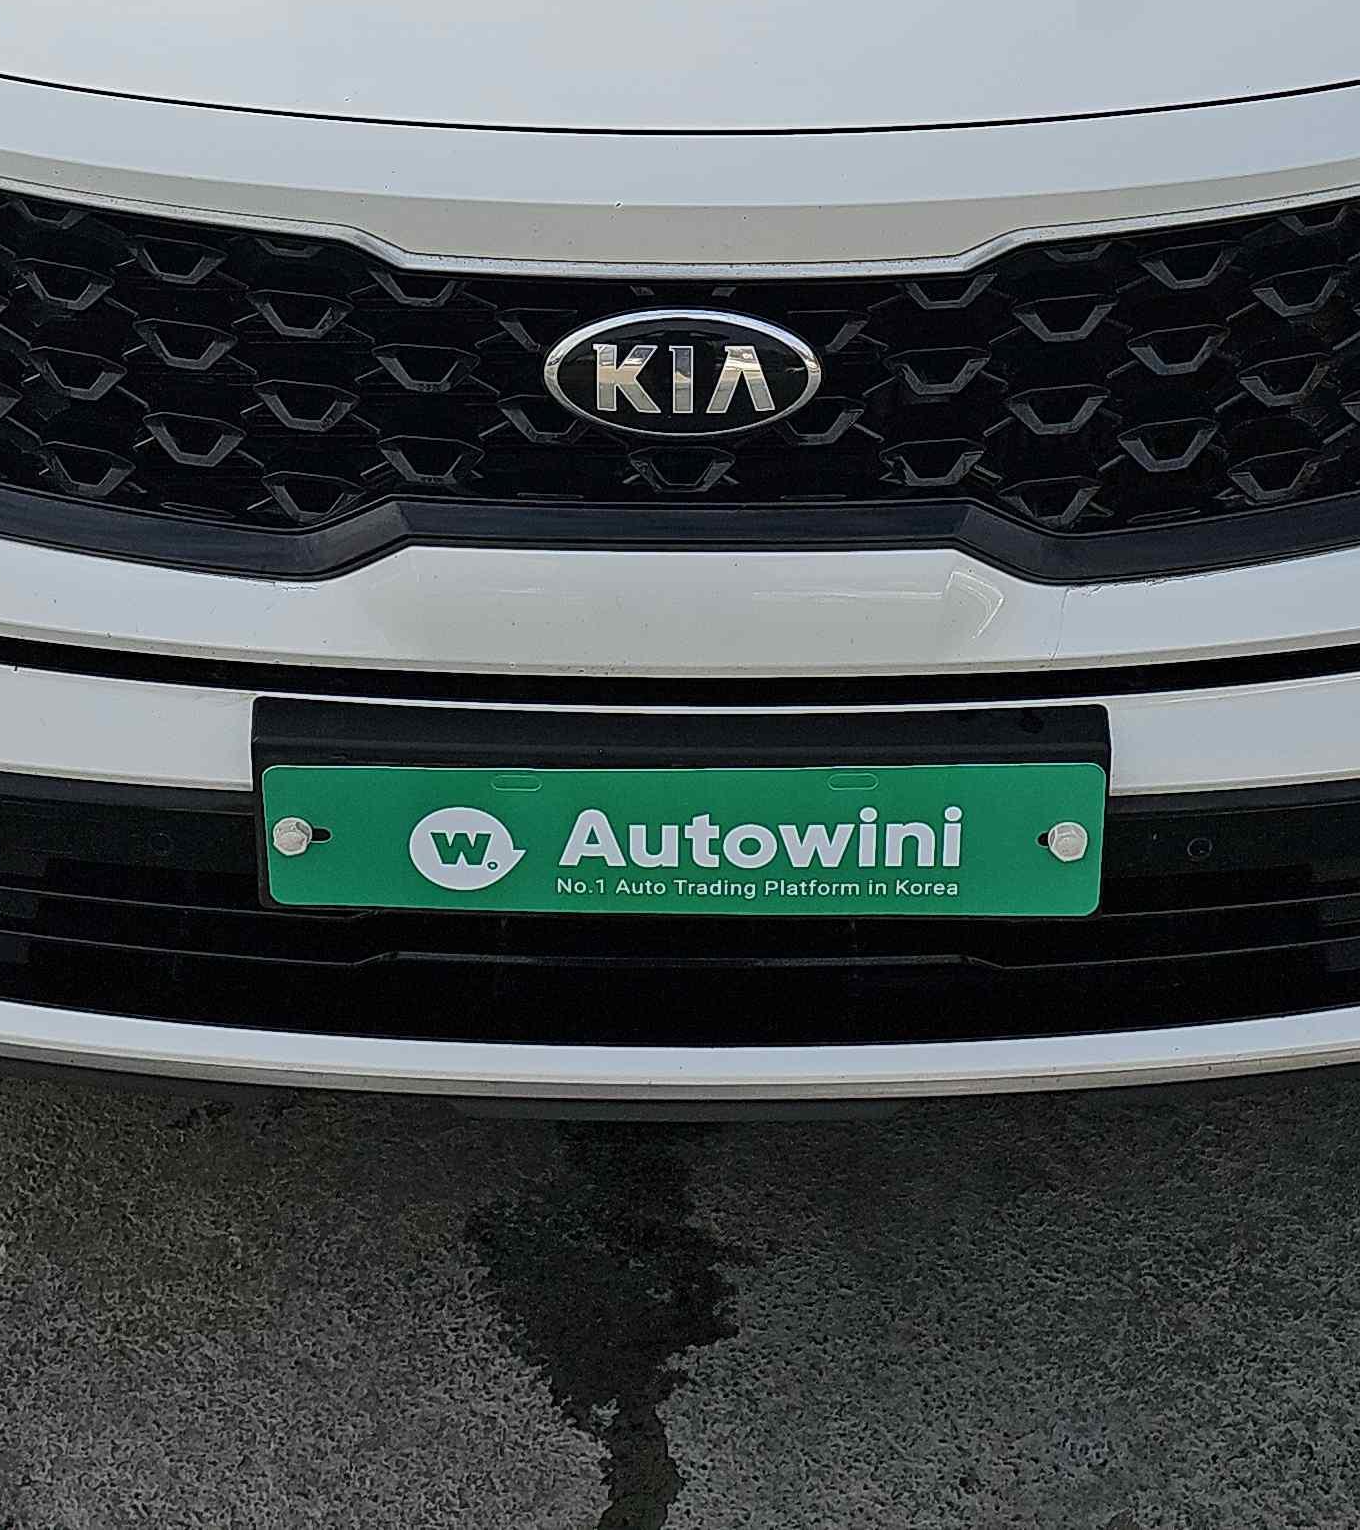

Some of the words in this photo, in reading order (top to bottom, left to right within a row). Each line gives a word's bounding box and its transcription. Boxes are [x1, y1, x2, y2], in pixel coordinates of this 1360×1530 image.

[593, 344, 776, 414] KIA
[558, 805, 963, 869] Autowini
[556, 877, 606, 895] No.1
[615, 878, 667, 896] Auto
[674, 878, 758, 900] Trading
[765, 878, 860, 898] Platform
[867, 880, 889, 896] in
[896, 880, 959, 898] Korea
